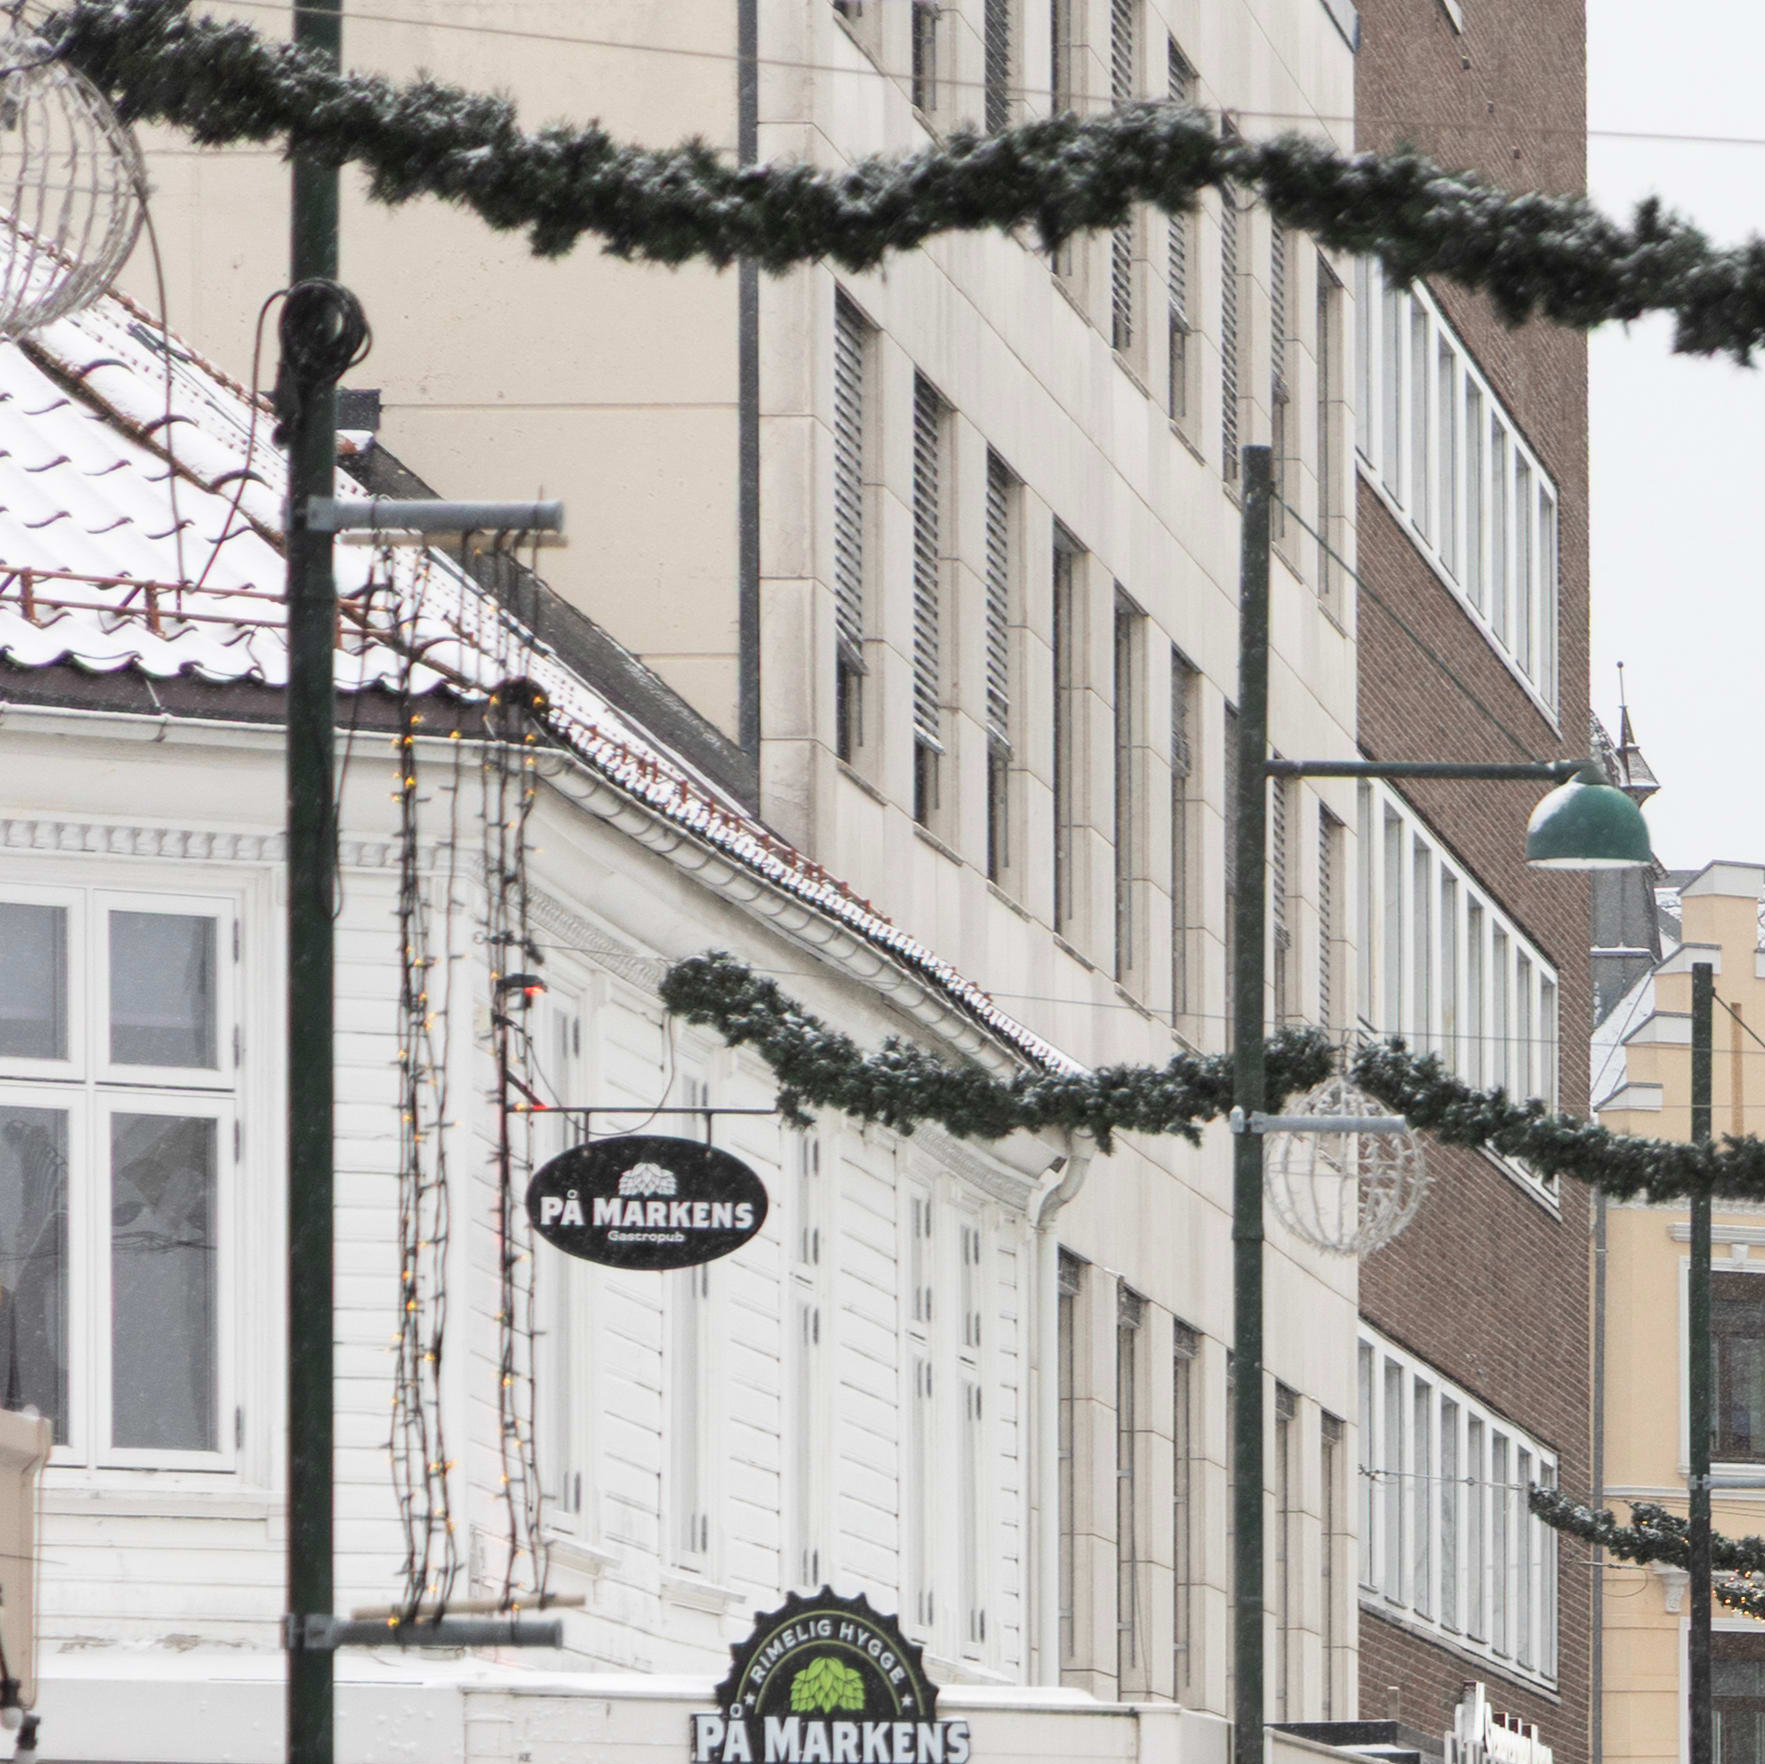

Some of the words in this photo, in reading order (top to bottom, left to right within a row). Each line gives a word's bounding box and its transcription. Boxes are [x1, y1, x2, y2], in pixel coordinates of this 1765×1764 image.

[541, 1189, 584, 1226] PÅ
[592, 1197, 755, 1230] MARKENS
[607, 1230, 685, 1244] Gastropub
[750, 1618, 832, 1684] RIMELIG
[839, 1622, 907, 1685] HYGGE
[695, 1703, 751, 1764] PÅ
[763, 1715, 972, 1764] MARKENS
